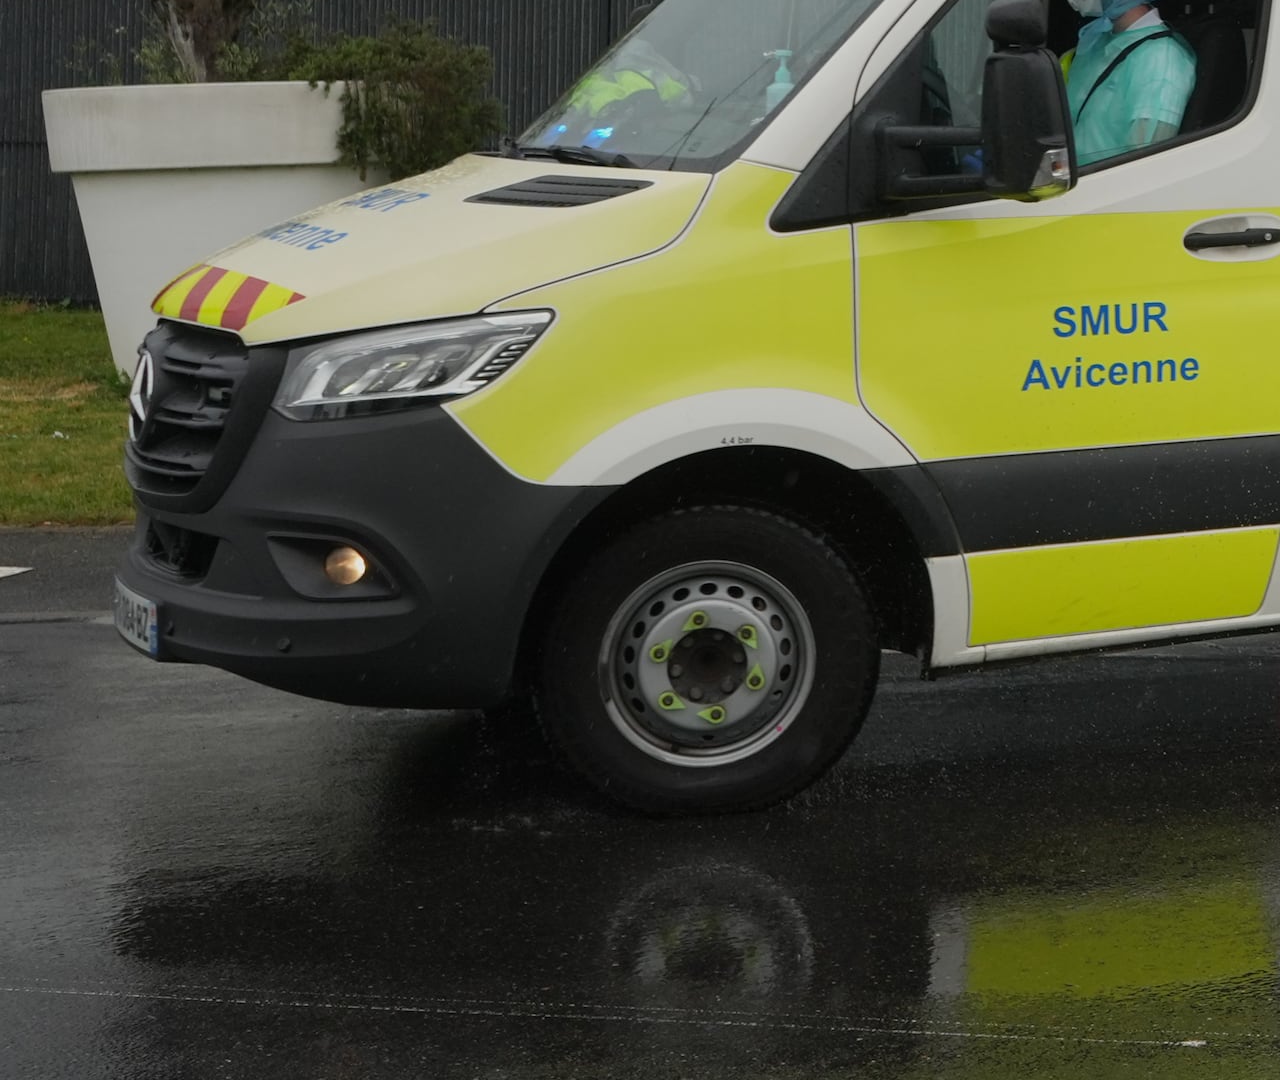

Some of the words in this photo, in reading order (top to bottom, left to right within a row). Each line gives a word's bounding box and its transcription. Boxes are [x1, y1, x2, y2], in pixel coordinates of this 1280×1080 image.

[1052, 301, 1169, 338] SMUR
[1021, 356, 1200, 391] Avicenne
[737, 436, 754, 444] bar
